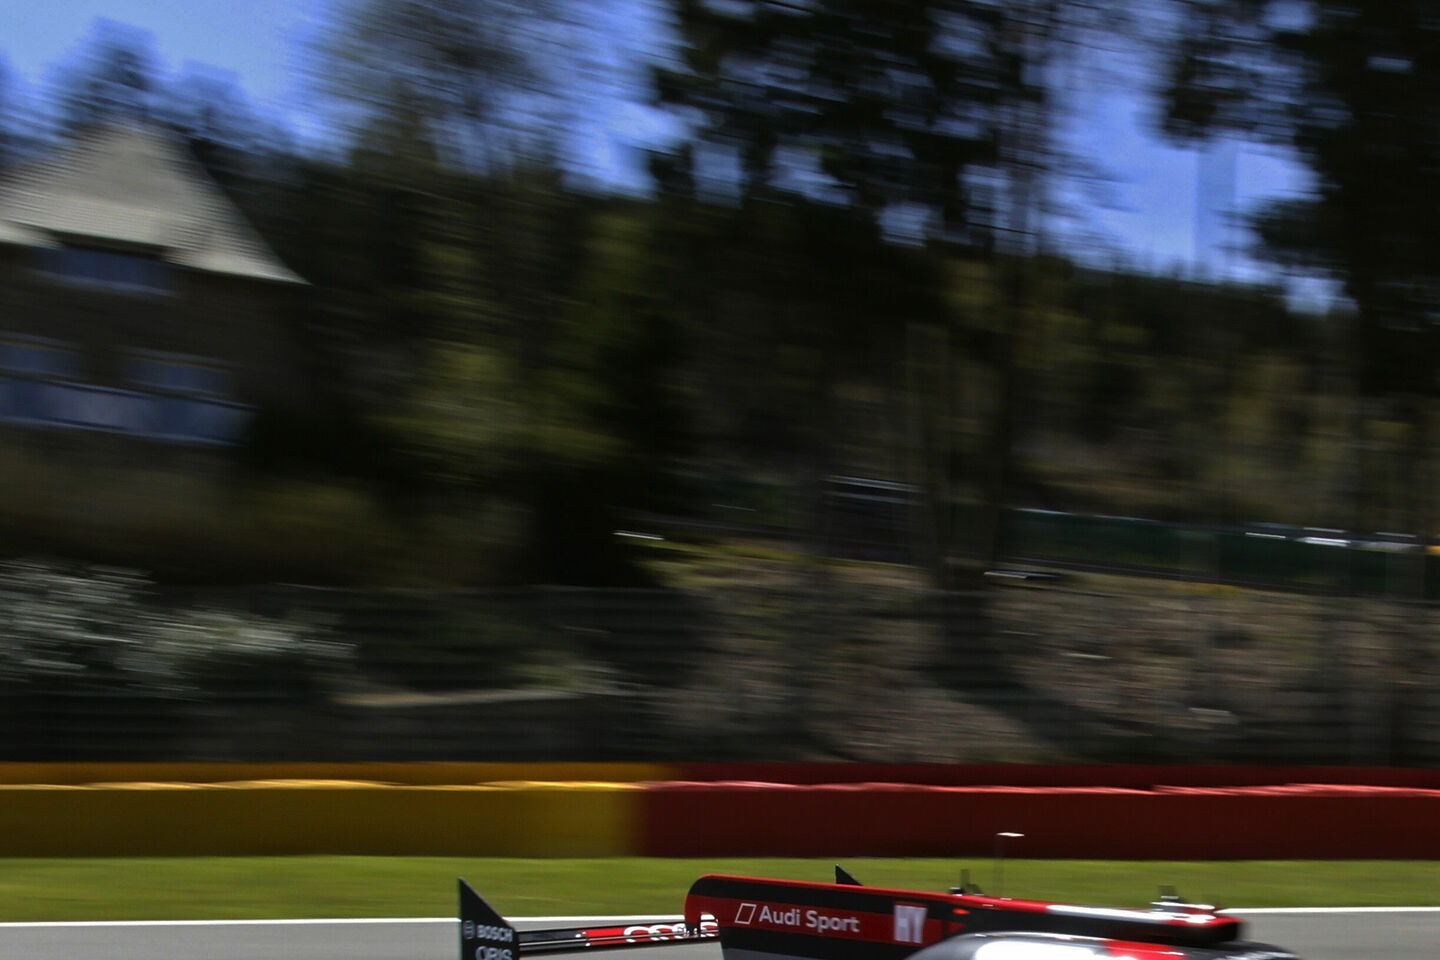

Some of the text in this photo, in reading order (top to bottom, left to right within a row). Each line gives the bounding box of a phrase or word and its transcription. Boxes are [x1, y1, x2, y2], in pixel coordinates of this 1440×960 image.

[759, 906, 860, 933] Audi Sport
[476, 924, 514, 943] BOSCH
